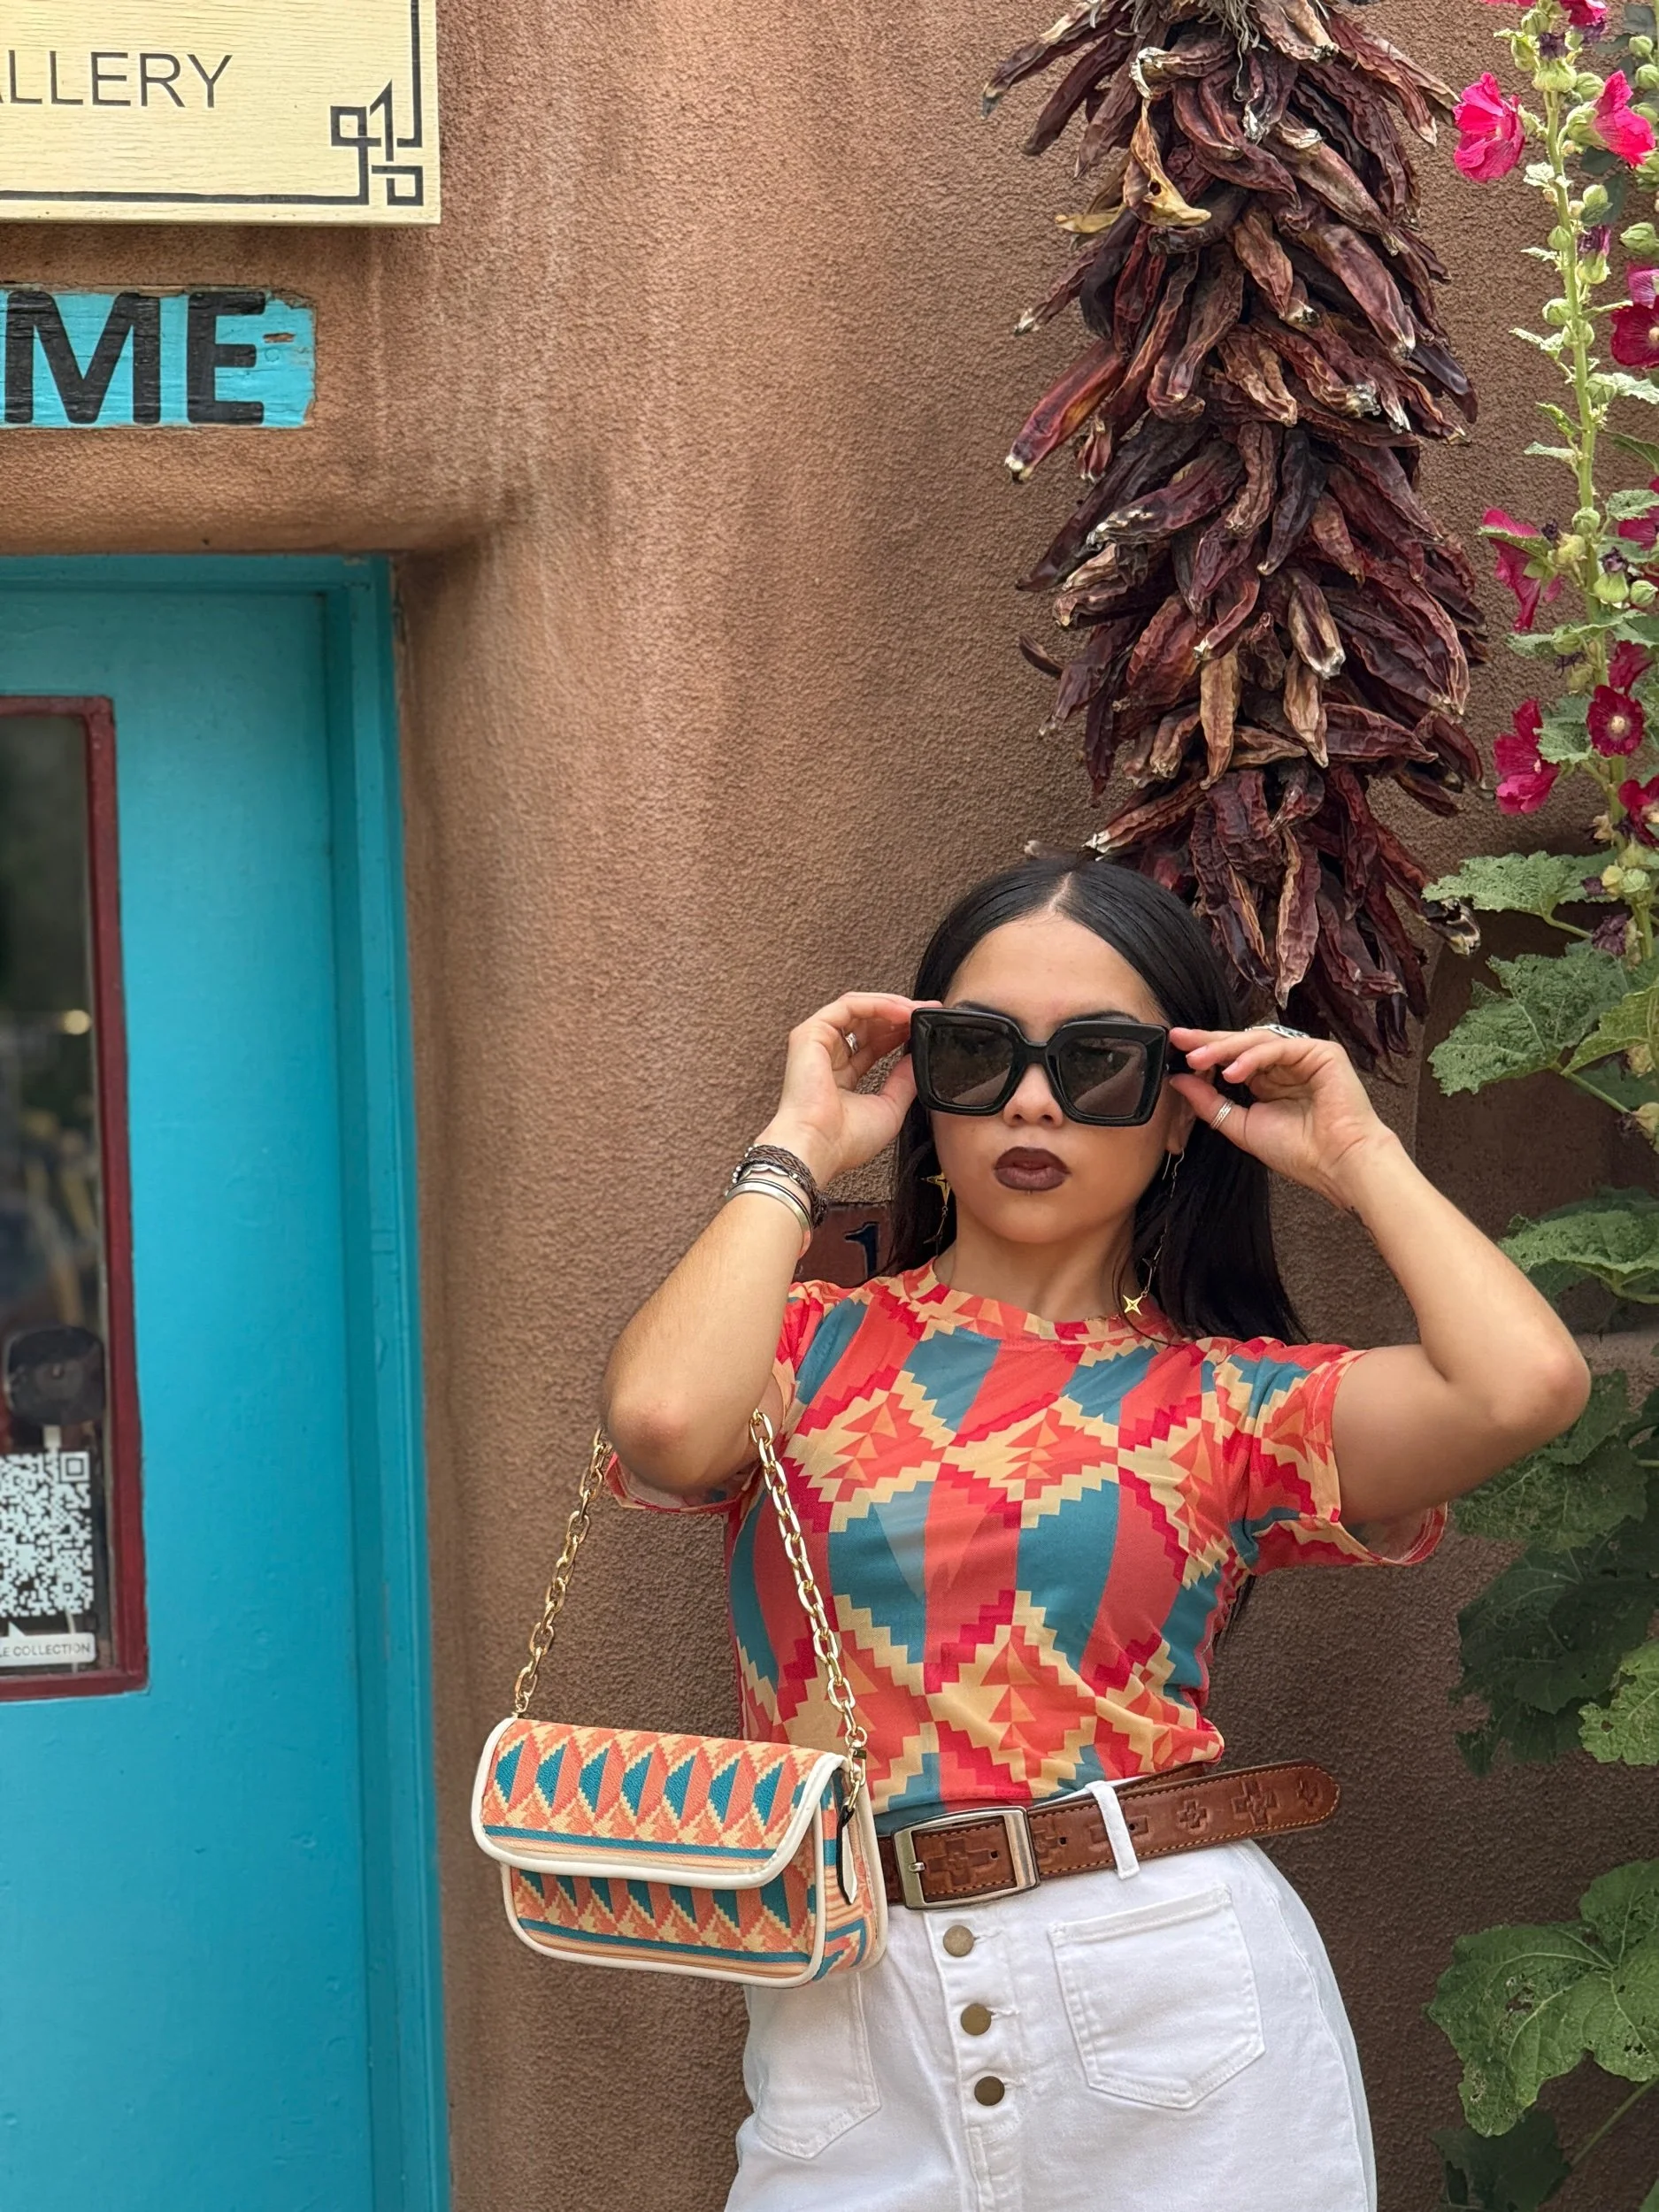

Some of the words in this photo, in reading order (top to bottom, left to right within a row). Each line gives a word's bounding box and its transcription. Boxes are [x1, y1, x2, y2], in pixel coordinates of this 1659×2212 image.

[0, 50, 233, 108] LLERY
[4, 291, 265, 425] ME
[12, 1642, 90, 1657] COLLECTION
